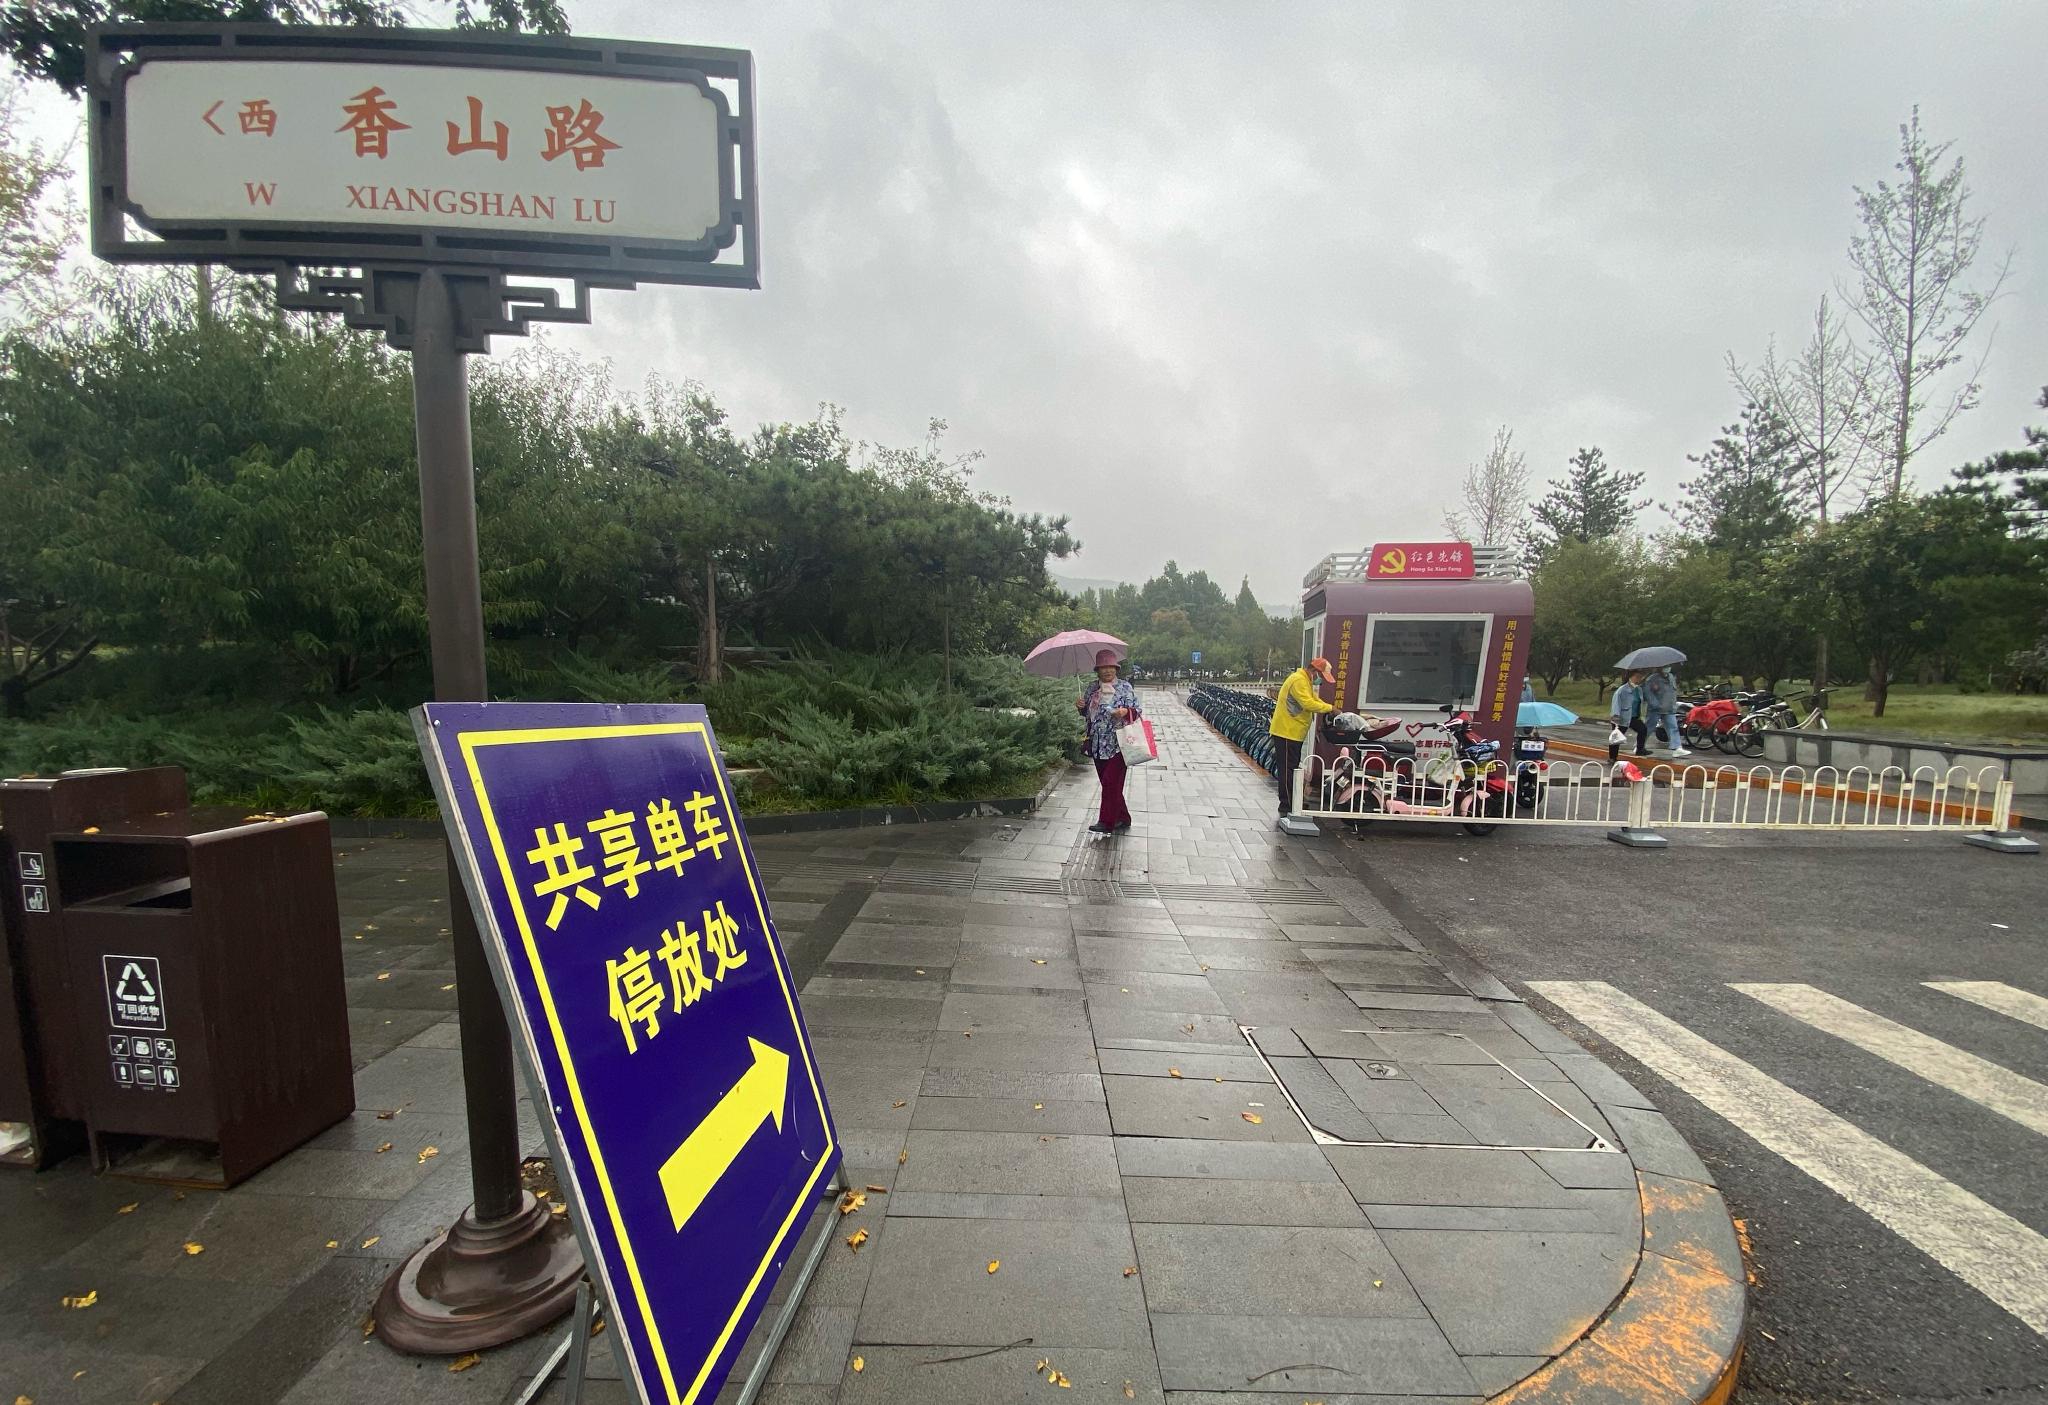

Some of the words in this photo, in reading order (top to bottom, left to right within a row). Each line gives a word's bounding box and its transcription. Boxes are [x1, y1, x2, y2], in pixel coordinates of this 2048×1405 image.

[237, 99, 278, 138] 西
[334, 85, 622, 172] 香山路
[244, 182, 278, 207] W
[345, 184, 556, 221] XIANGSHAN
[574, 197, 617, 224] LU
[1410, 549, 1463, 563] 红色先锋
[1491, 620, 1517, 722] 用心用情做好志愿服务
[525, 790, 729, 932] 共享单车
[116, 1003, 160, 1016] 可回收物
[605, 900, 747, 1056] 停放处
